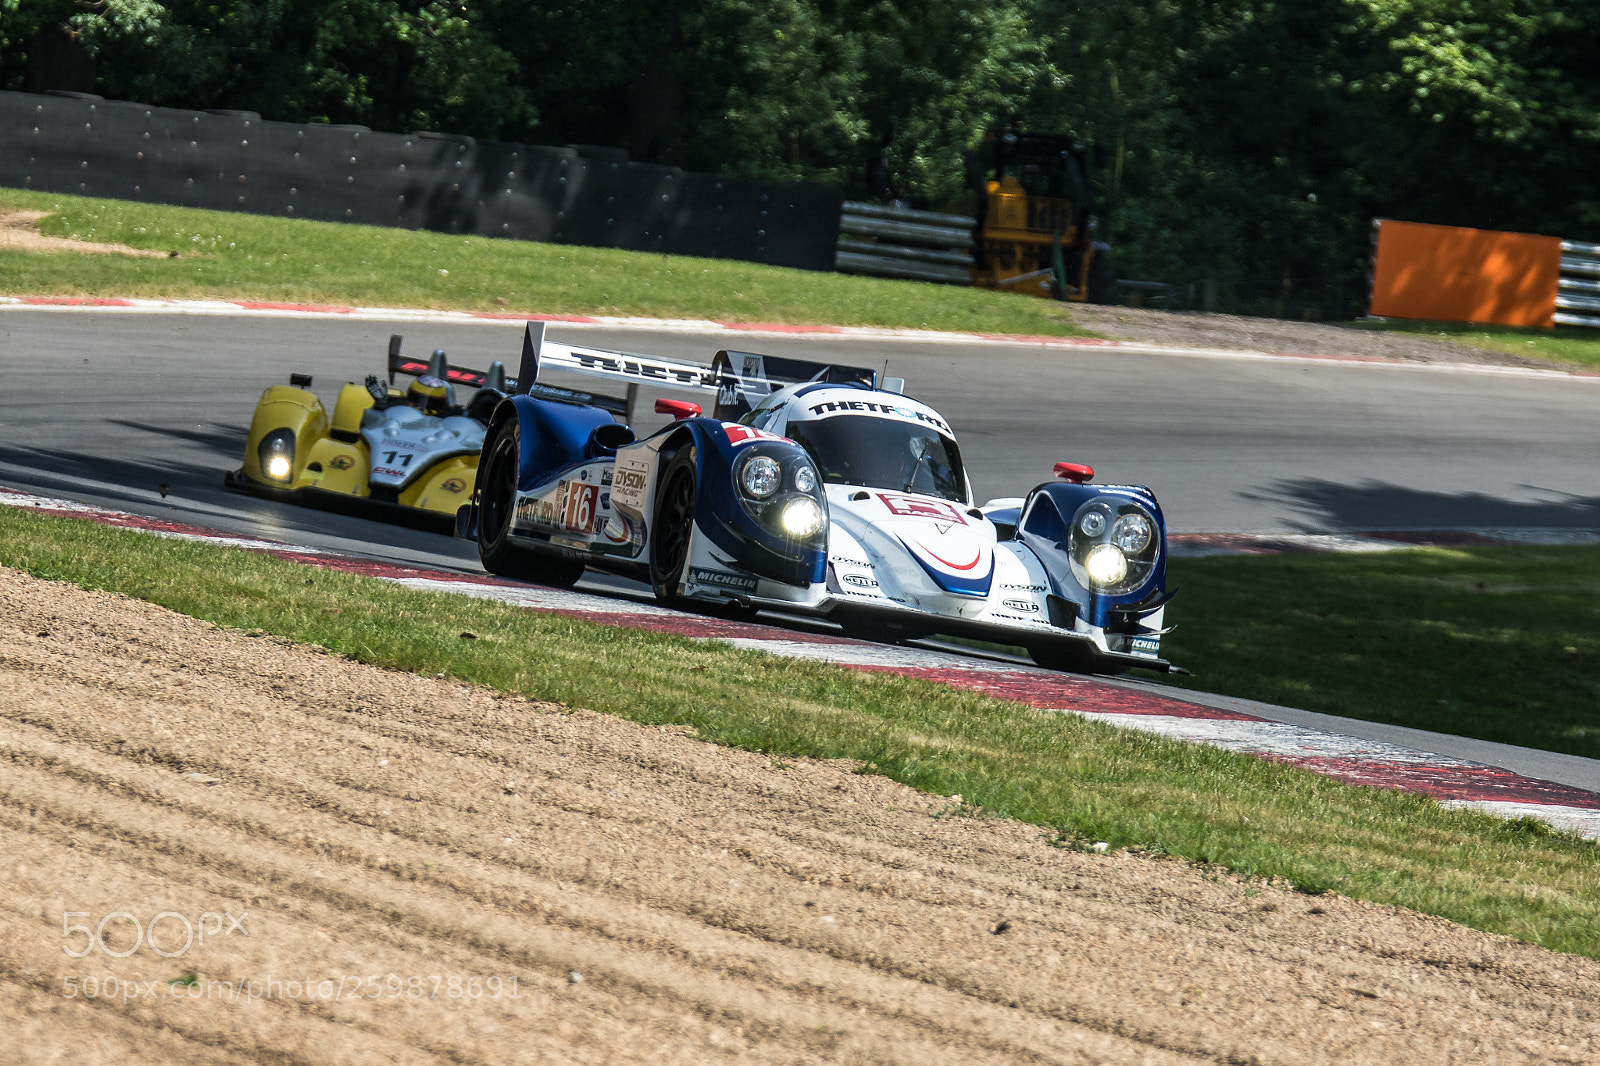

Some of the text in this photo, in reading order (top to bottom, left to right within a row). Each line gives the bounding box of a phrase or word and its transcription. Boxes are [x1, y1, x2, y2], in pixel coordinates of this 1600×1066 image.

[808, 401, 952, 434] THETFORD
[382, 450, 414, 467] 11
[615, 470, 646, 489] DYSON
[571, 485, 593, 531] 16
[697, 571, 757, 588] MICHELIN
[845, 576, 879, 587] HELLA
[1005, 601, 1039, 612] HELLA
